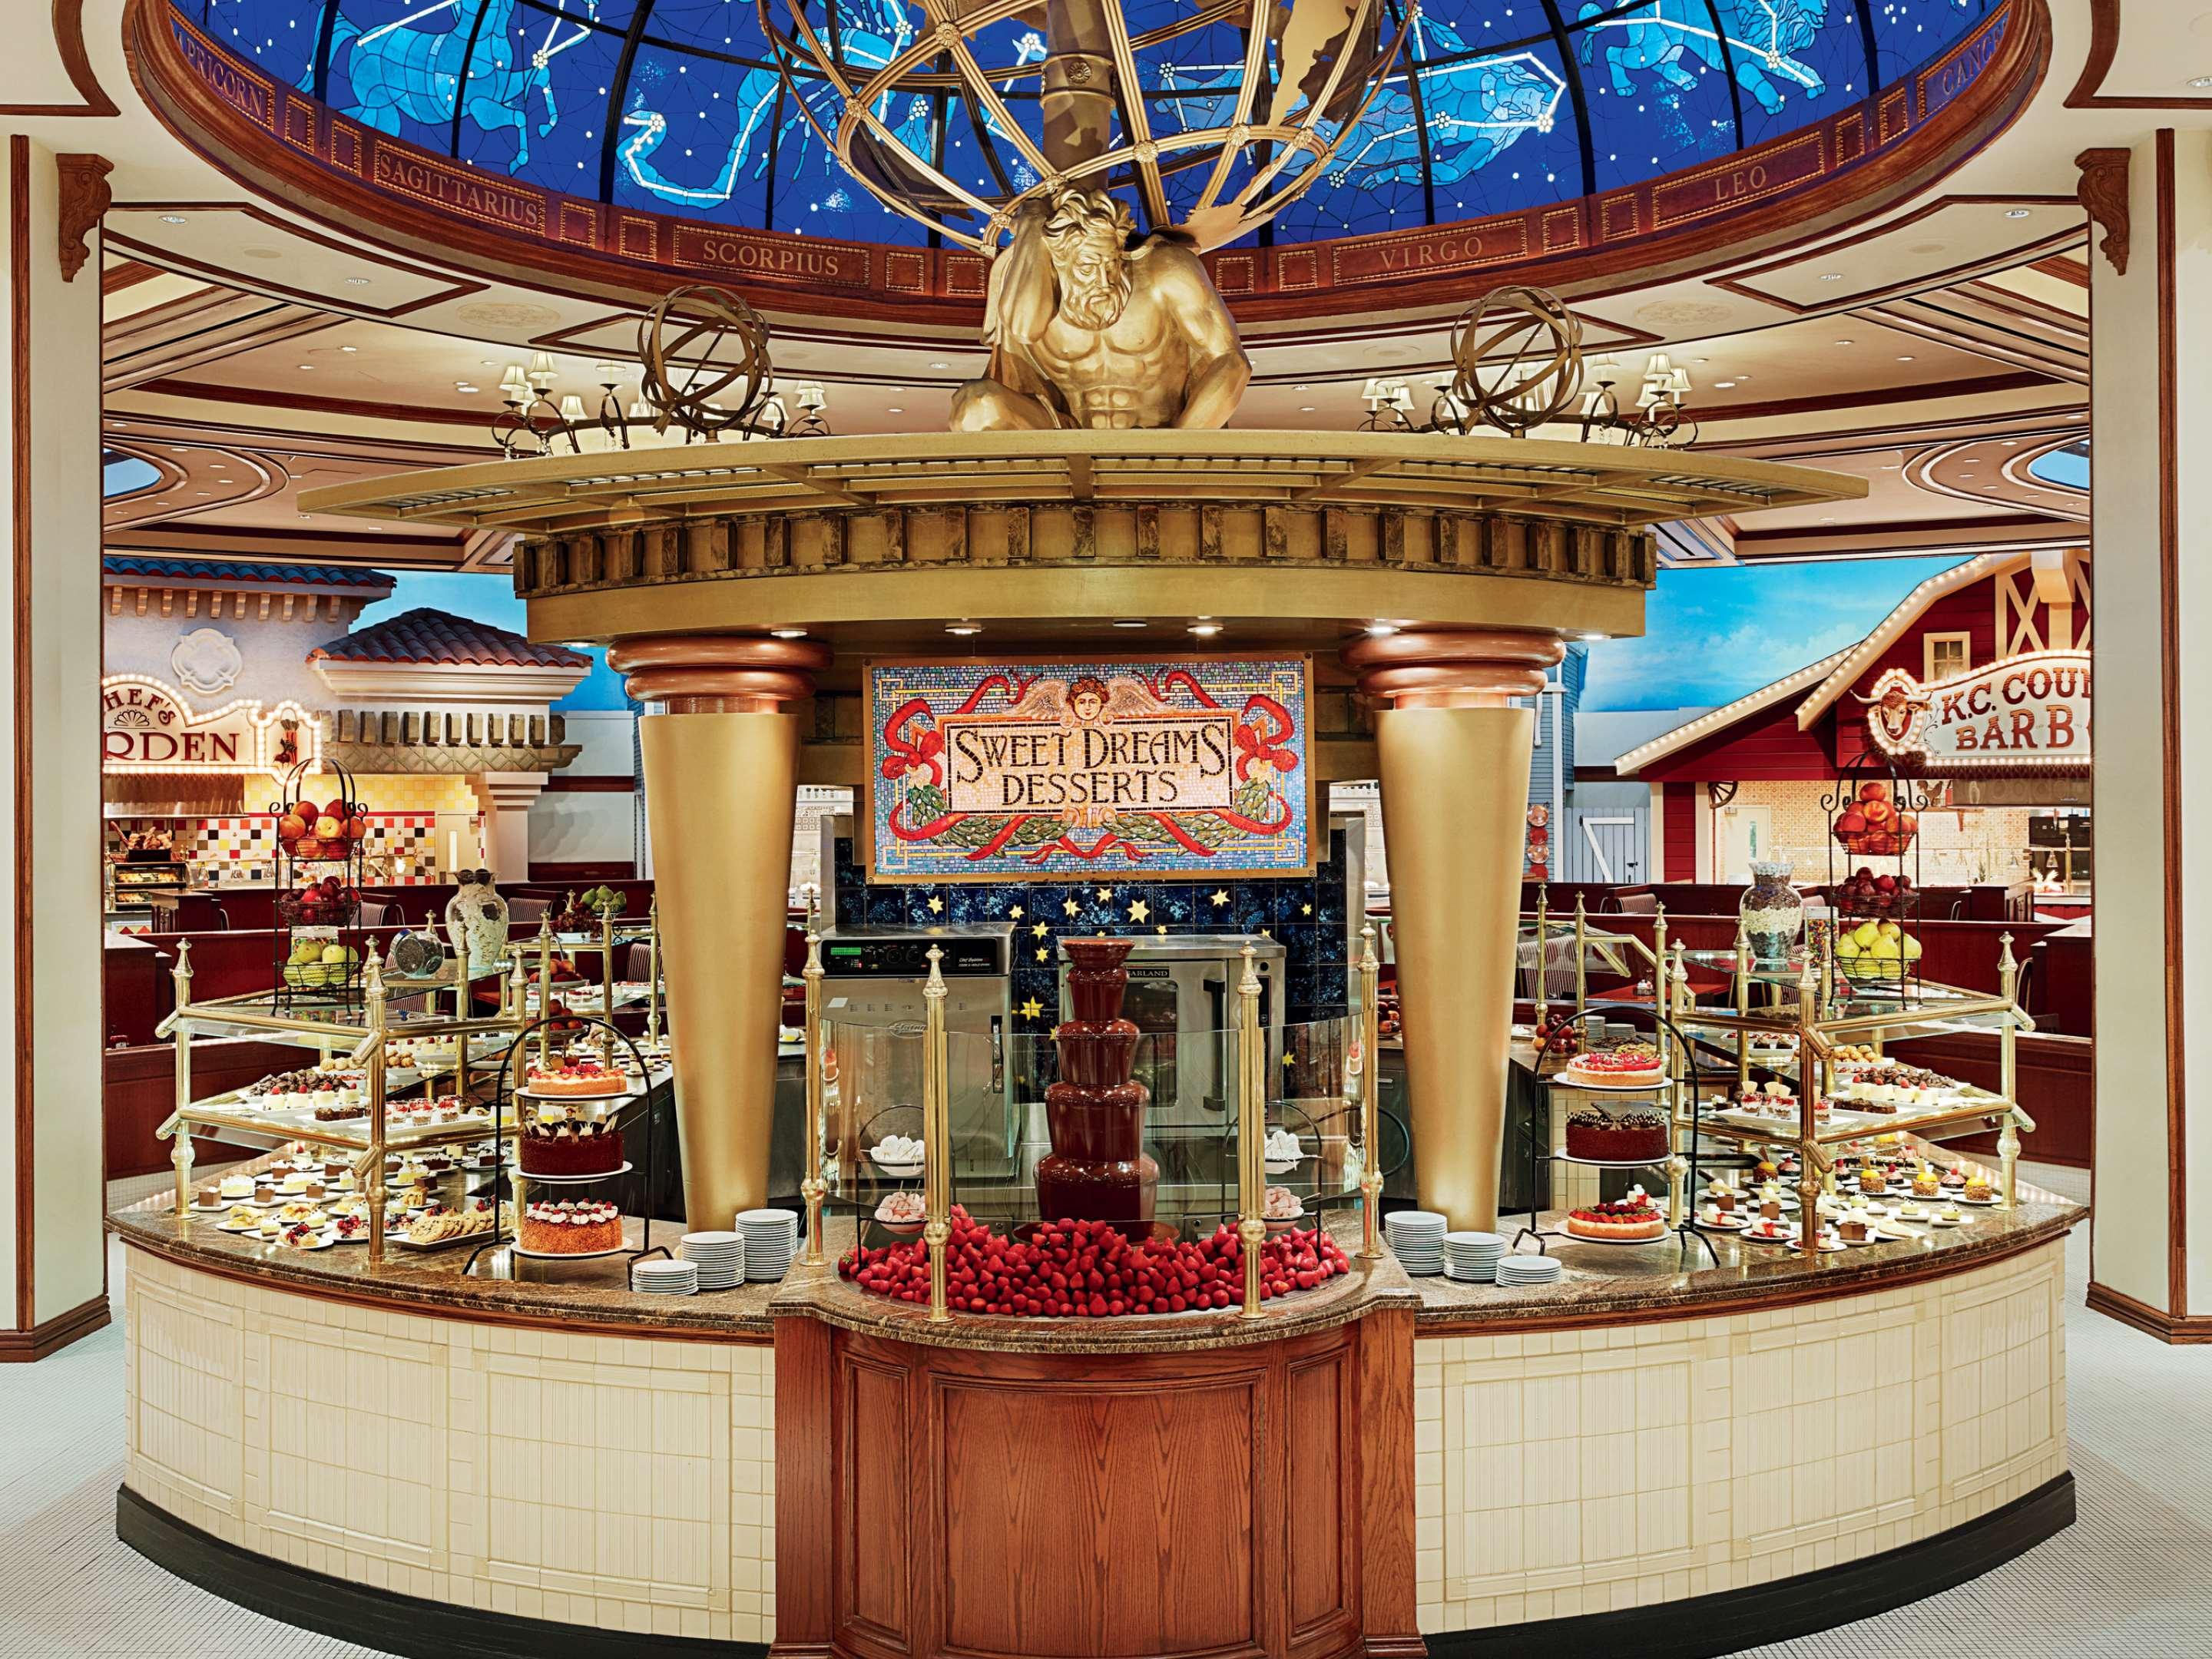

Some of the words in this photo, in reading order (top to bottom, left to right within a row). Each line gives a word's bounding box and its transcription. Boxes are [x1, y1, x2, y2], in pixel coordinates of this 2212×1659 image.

[1942, 19, 2006, 96] CANCE
[379, 154, 537, 224] SAGITTARIUS
[1715, 166, 1767, 201] LEO
[703, 240, 839, 276] SCORPIUS
[1379, 237, 1483, 269] VIRGO
[104, 688, 176, 725] HEF'S
[1941, 682, 1996, 725] K.C.
[955, 730, 1071, 783] SWEET
[1082, 724, 1225, 778] DREAMS
[1002, 770, 1177, 805] DESSERTS
